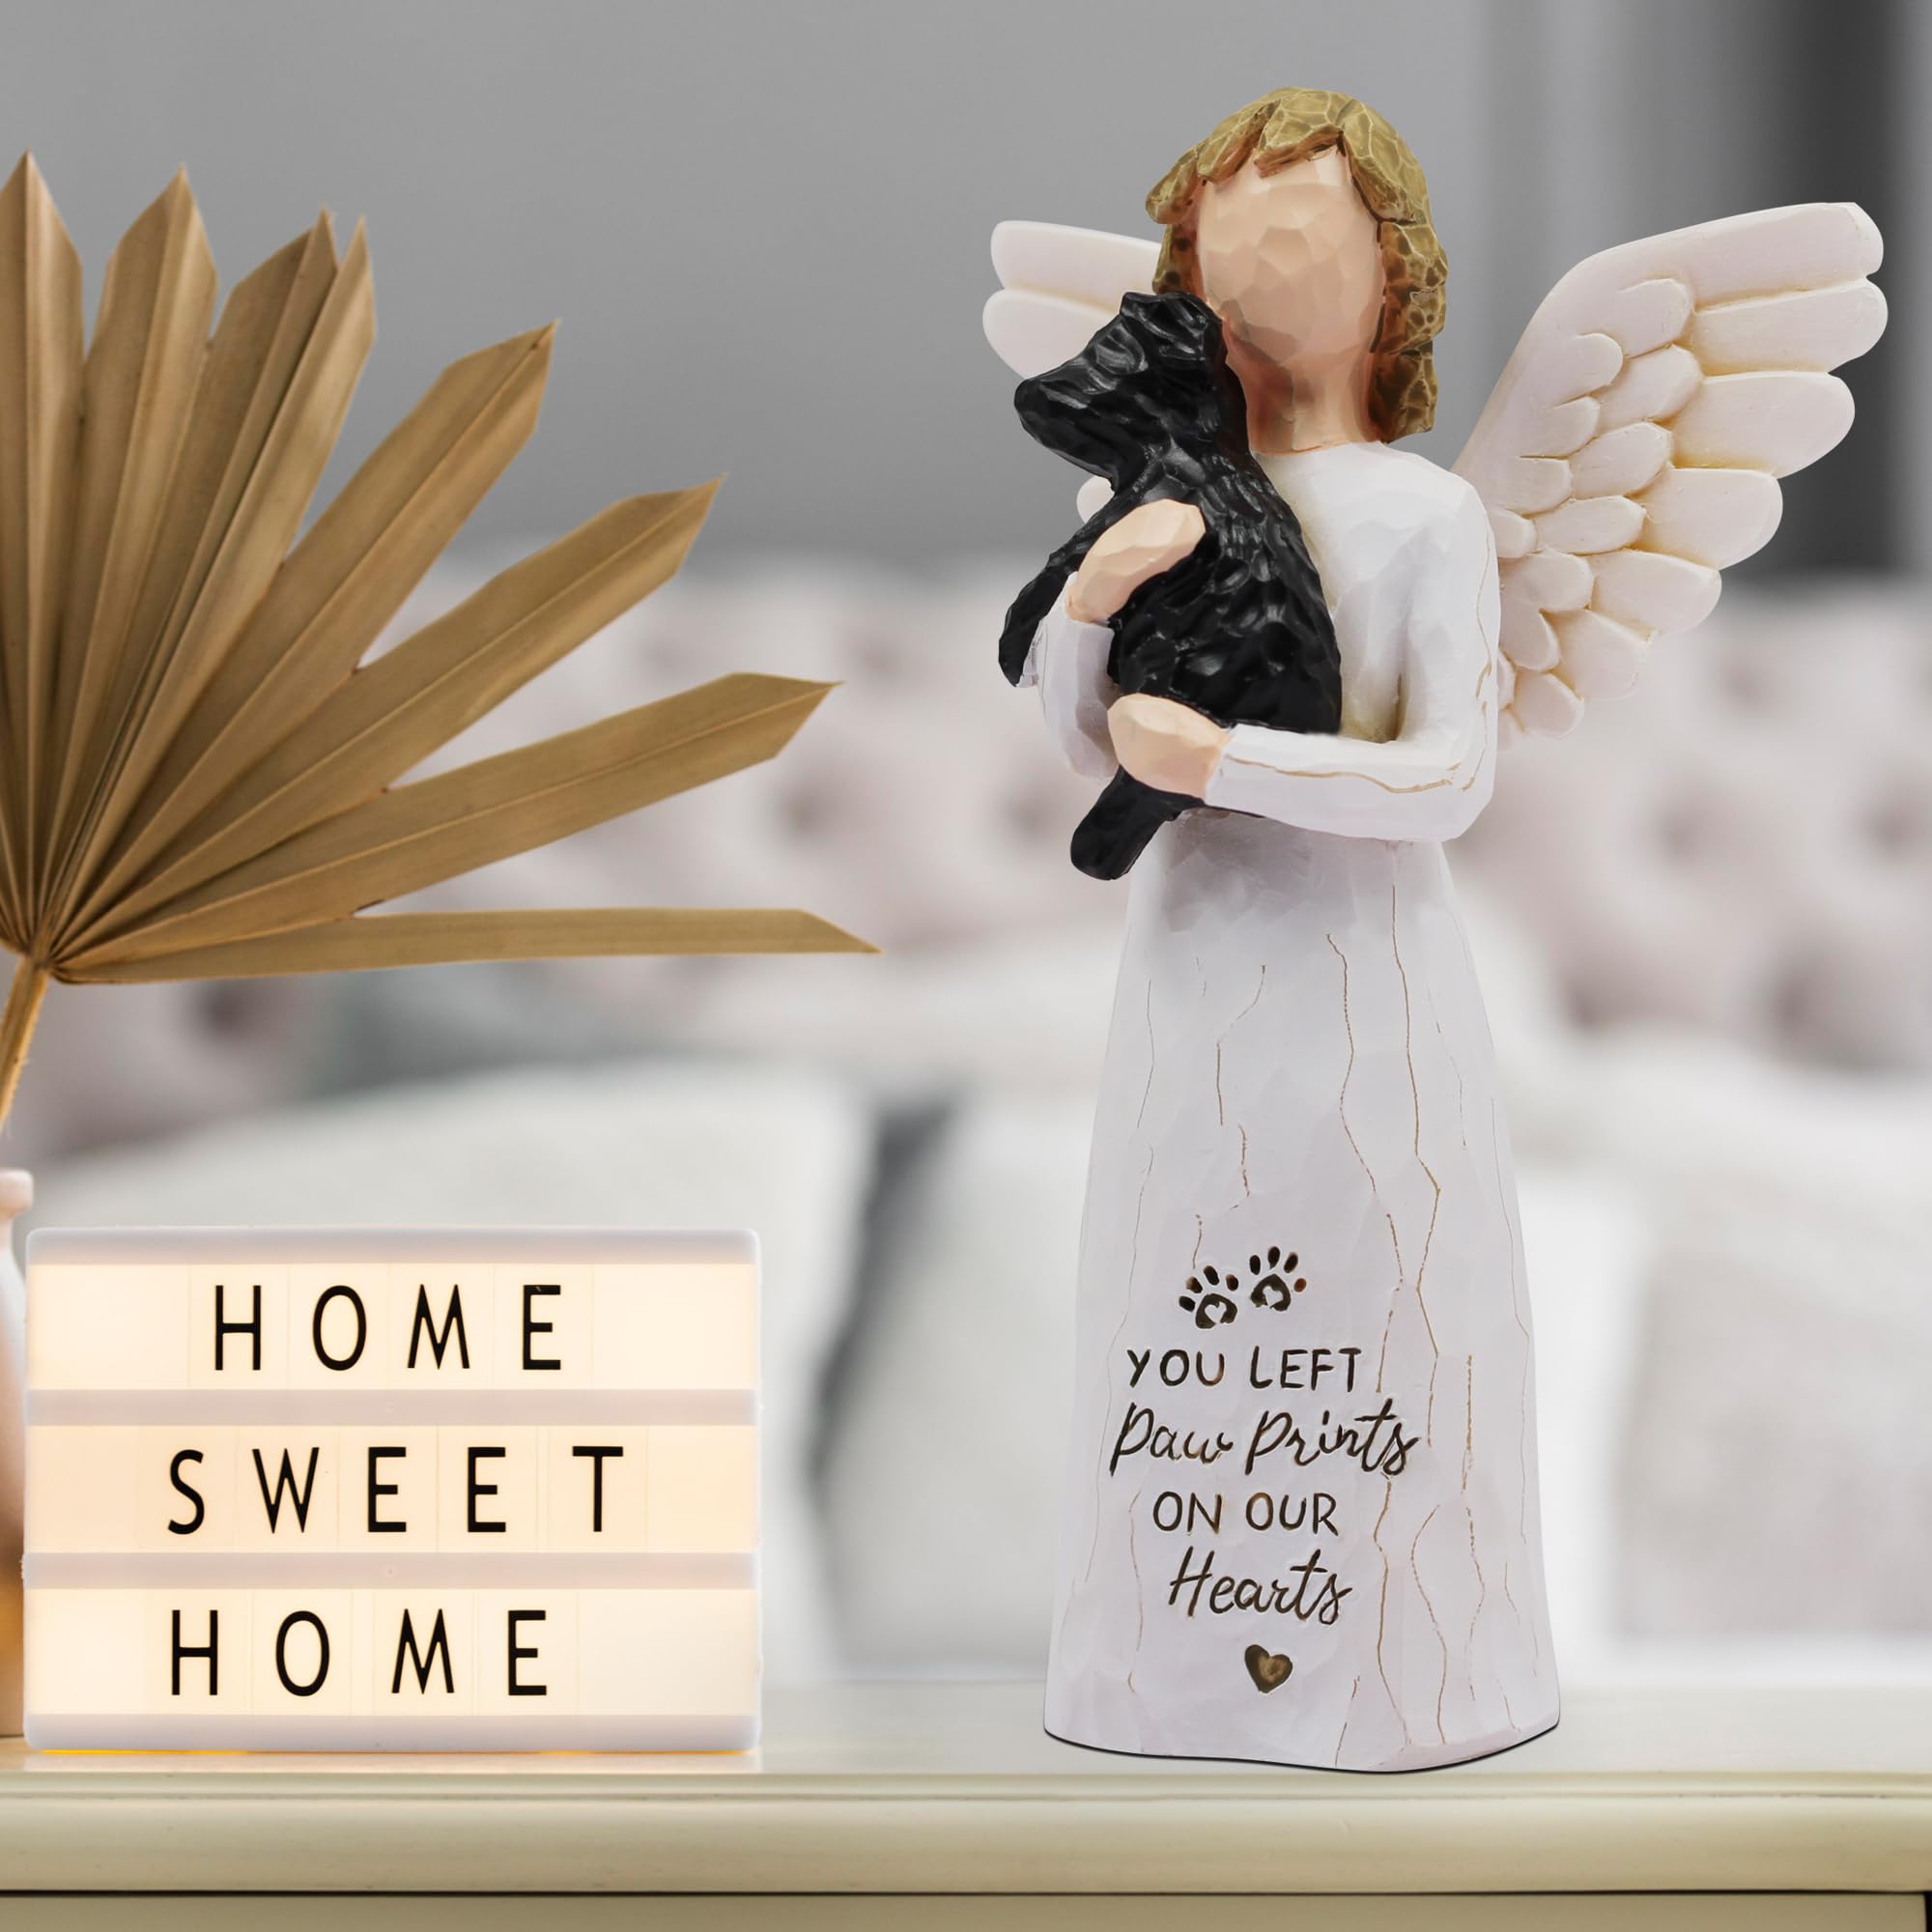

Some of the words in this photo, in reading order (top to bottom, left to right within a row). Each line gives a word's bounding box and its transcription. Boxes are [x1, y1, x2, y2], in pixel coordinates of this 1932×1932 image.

[214, 1284, 562, 1372] HOME
[1126, 1349, 1225, 1388] YOU
[1249, 1347, 1363, 1393] LEFT
[167, 1445, 625, 1535] SWEET
[1152, 1491, 1223, 1535] ON
[1245, 1491, 1340, 1537] OUR
[1168, 1546, 1353, 1626] Hearts
[171, 1608, 548, 1697] HOME
